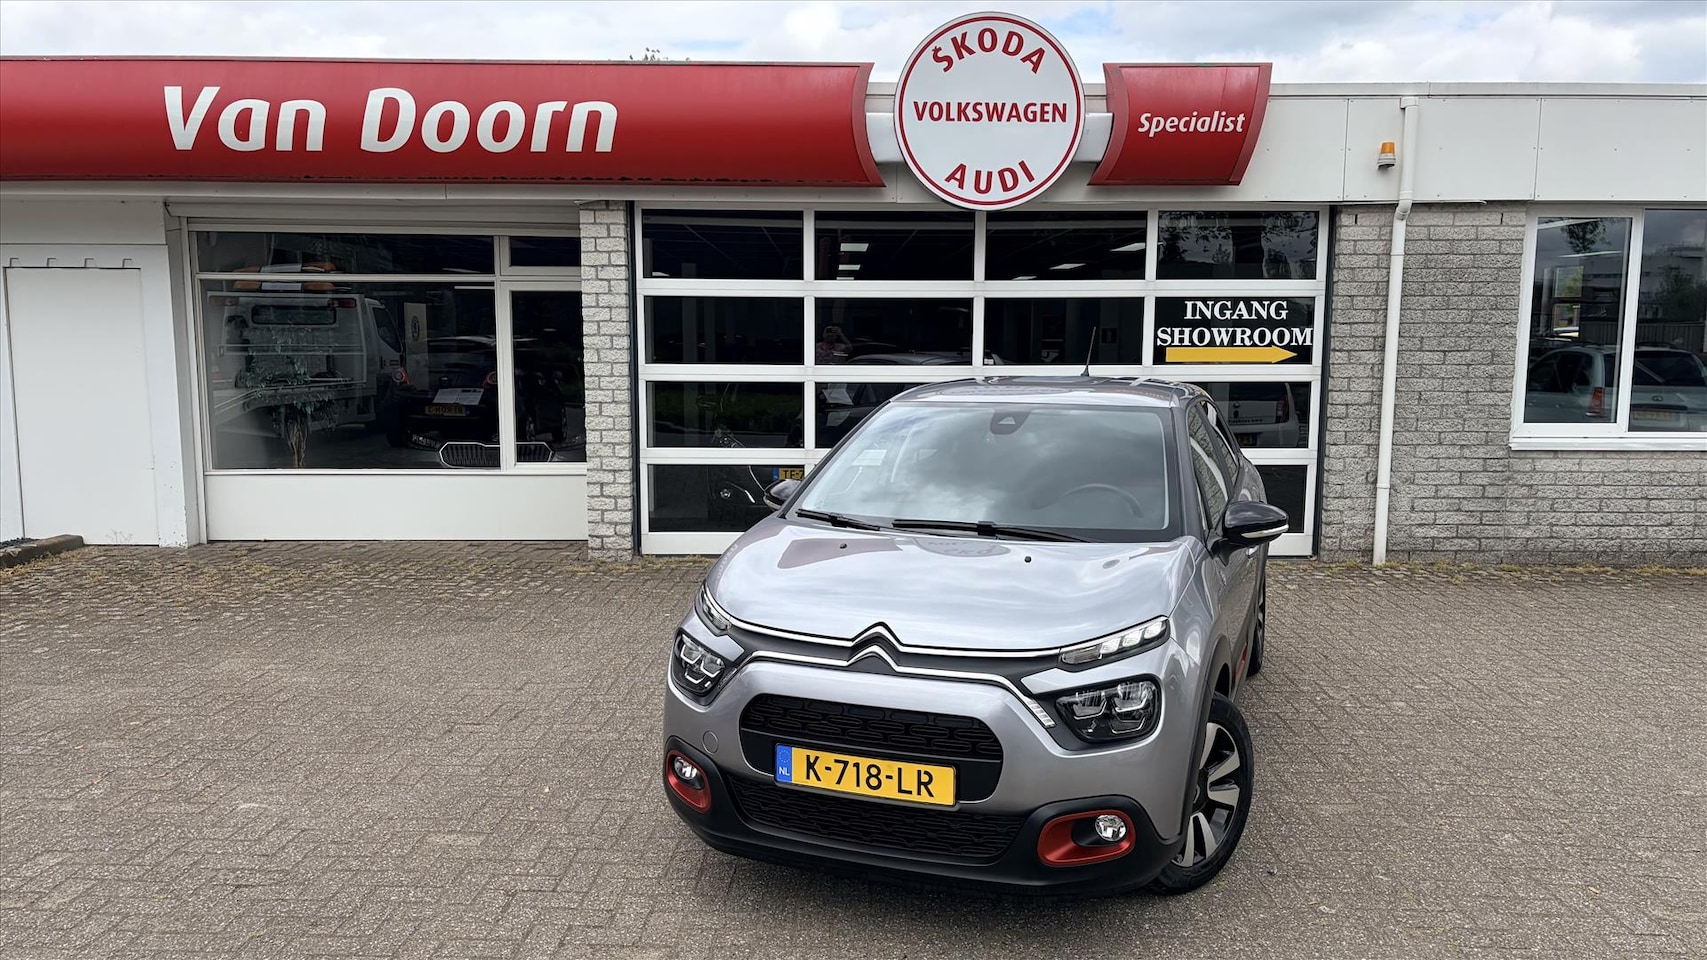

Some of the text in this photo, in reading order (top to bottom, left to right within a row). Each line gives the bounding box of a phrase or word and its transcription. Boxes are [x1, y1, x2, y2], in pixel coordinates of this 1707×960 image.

[932, 27, 1046, 74] ŠKODA
[163, 86, 618, 153] Van Doorn
[913, 101, 1068, 123] VOLKSWAGEN
[1138, 111, 1246, 137] Specialist
[944, 159, 1036, 195] AUDI
[1184, 300, 1289, 320] INGANG
[1156, 327, 1314, 346] SHOWROOM
[778, 754, 934, 798] NL K-718-LR
